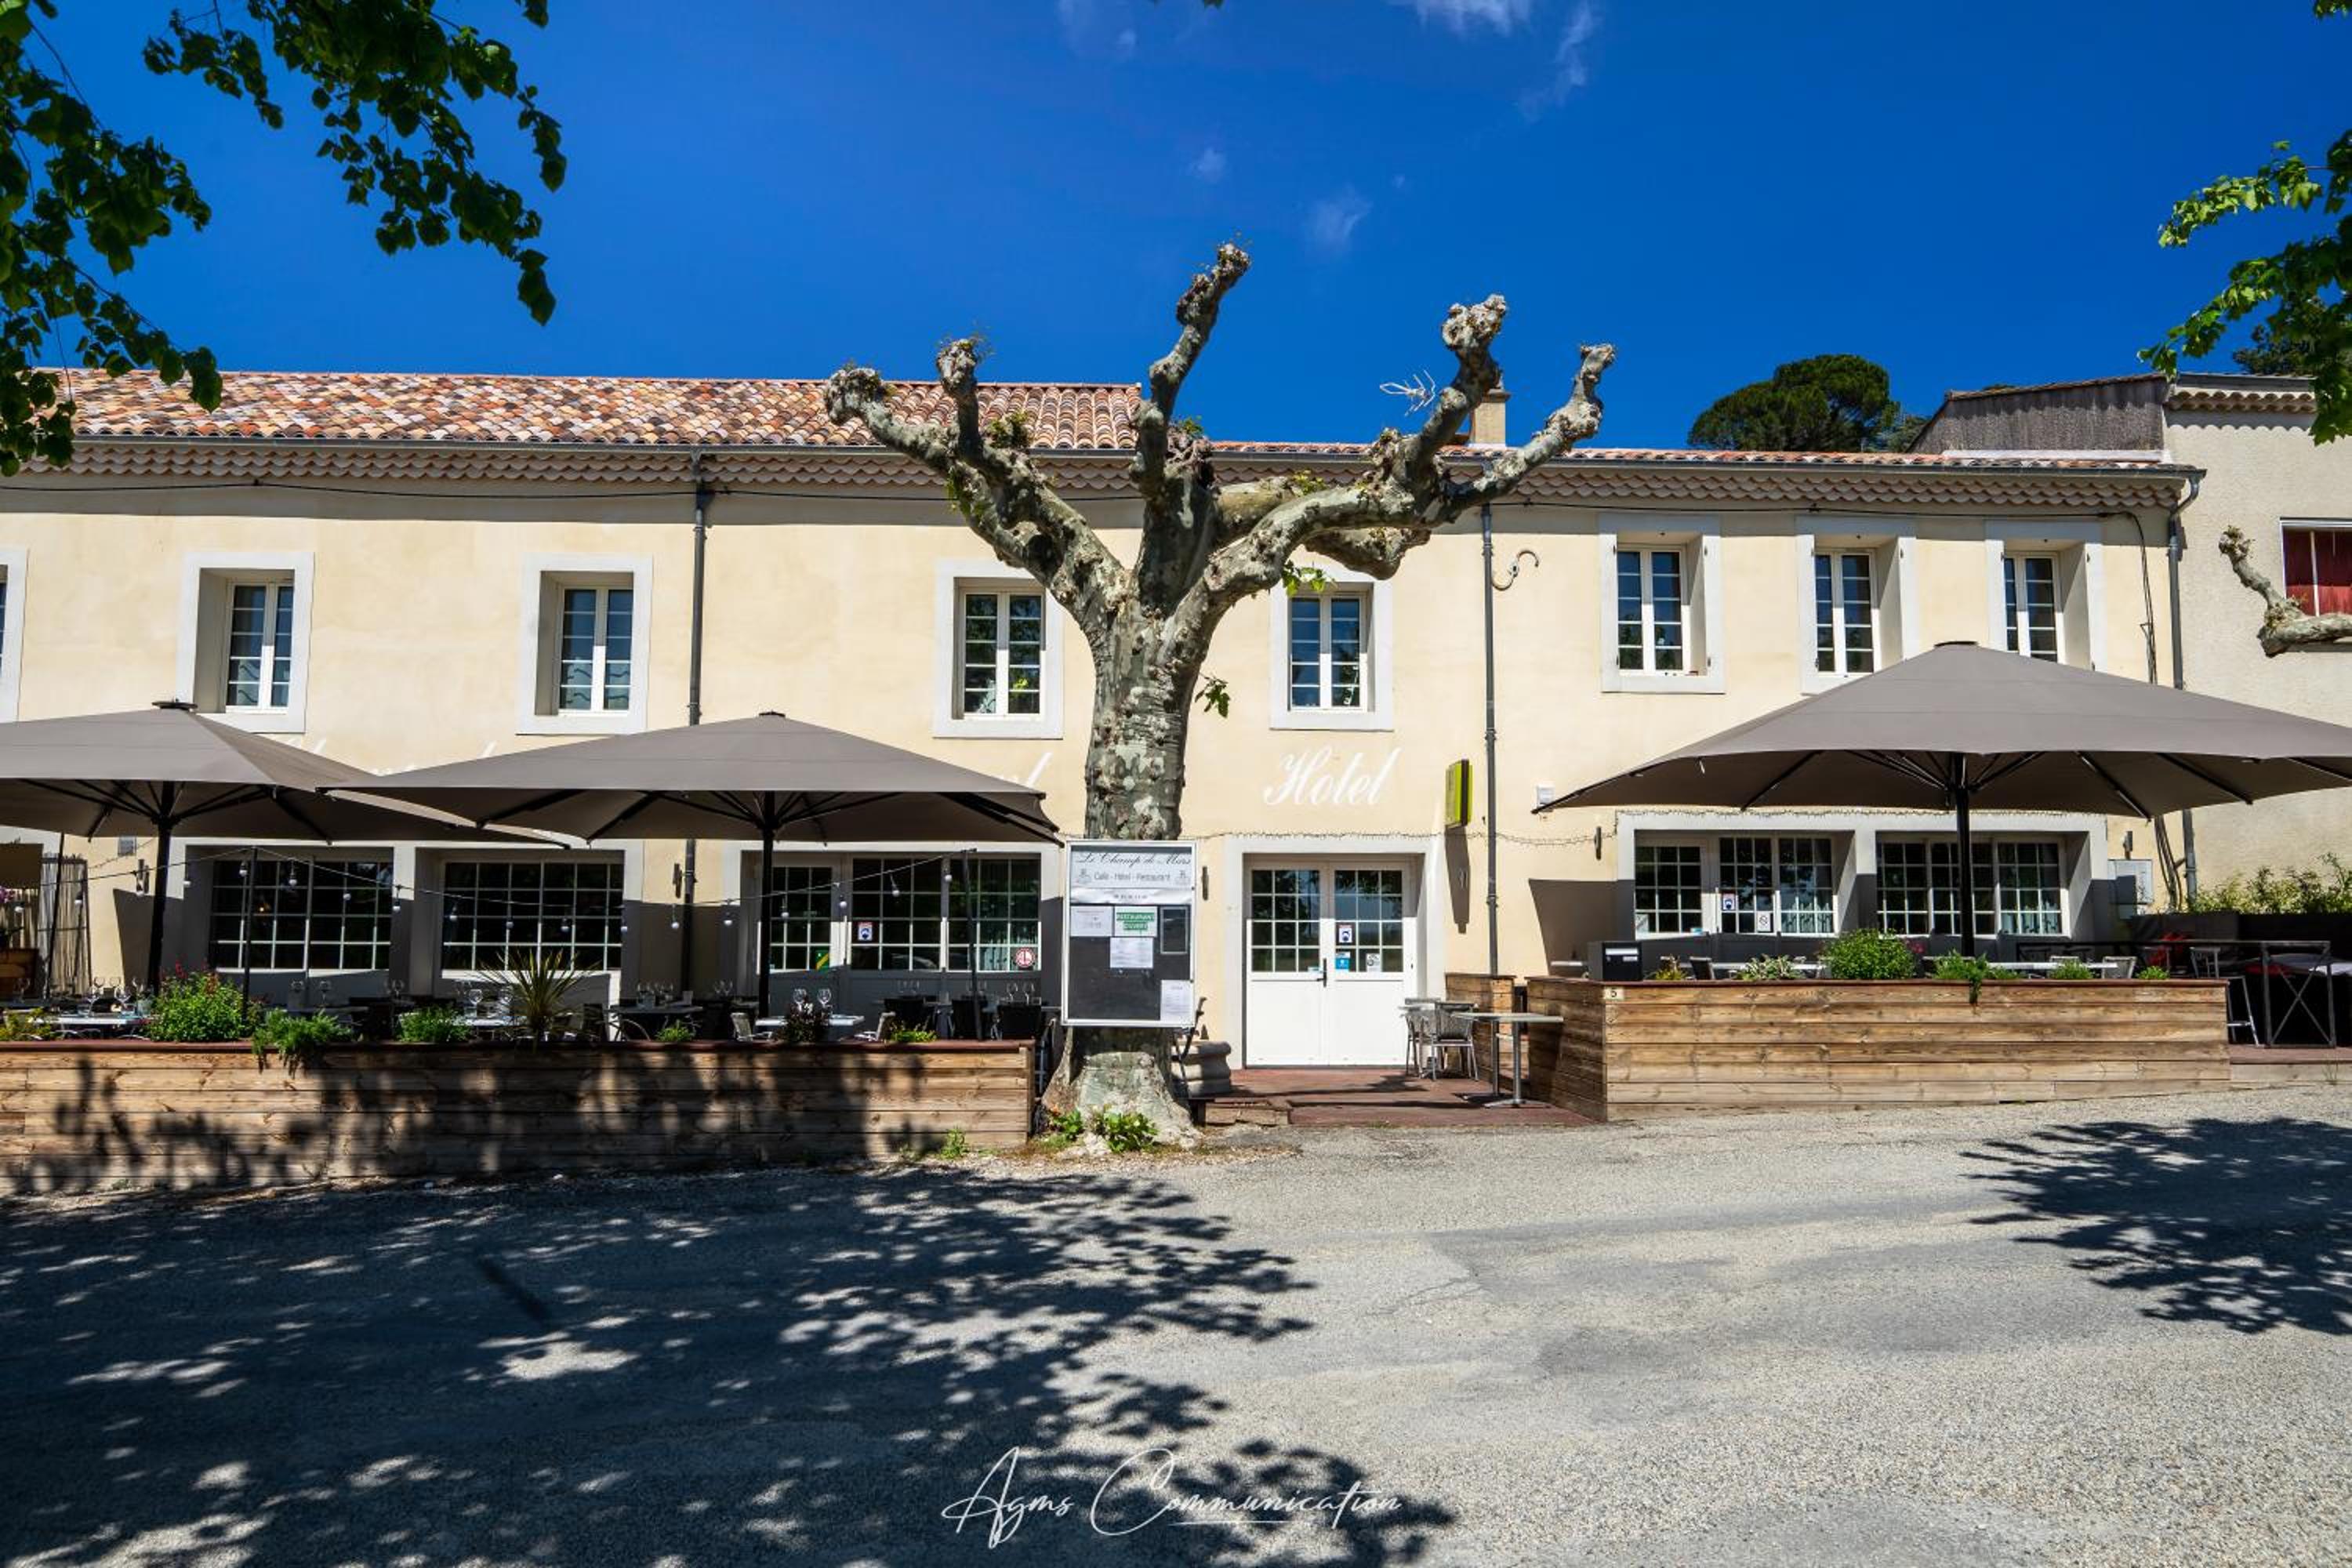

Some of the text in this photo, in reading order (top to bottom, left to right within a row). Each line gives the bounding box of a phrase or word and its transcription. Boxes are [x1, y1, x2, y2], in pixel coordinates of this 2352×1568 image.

[1101, 852, 1140, 868] Champ
[1145, 854, 1155, 863] de
[1158, 853, 1191, 865] Mars
